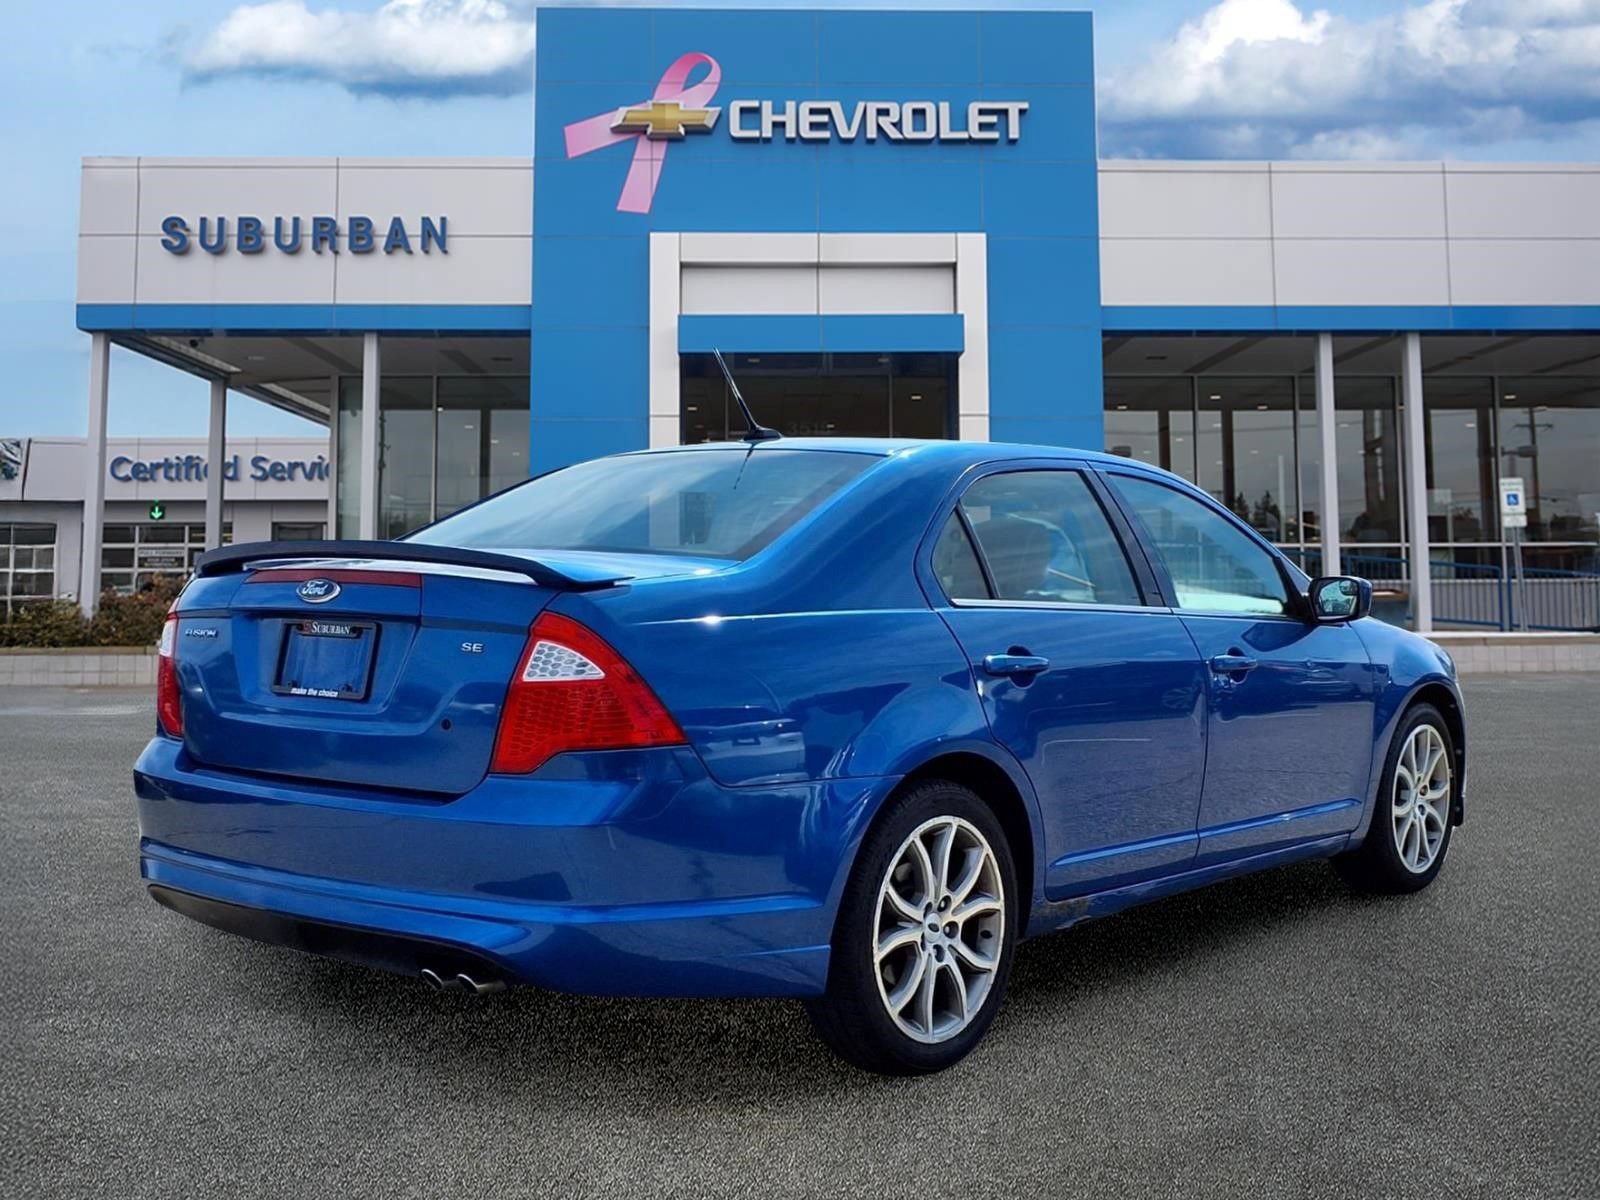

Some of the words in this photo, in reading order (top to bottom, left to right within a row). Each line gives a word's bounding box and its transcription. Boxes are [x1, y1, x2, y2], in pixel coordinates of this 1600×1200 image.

[729, 99, 1028, 142] CHEVROLET
[161, 215, 449, 255] SUBURBAN
[302, 581, 327, 596] Ford
[311, 621, 350, 634] SUBURBAN
[461, 641, 484, 653] SE
[290, 687, 307, 696] make
[307, 688, 318, 696] the
[318, 689, 339, 698] choice
